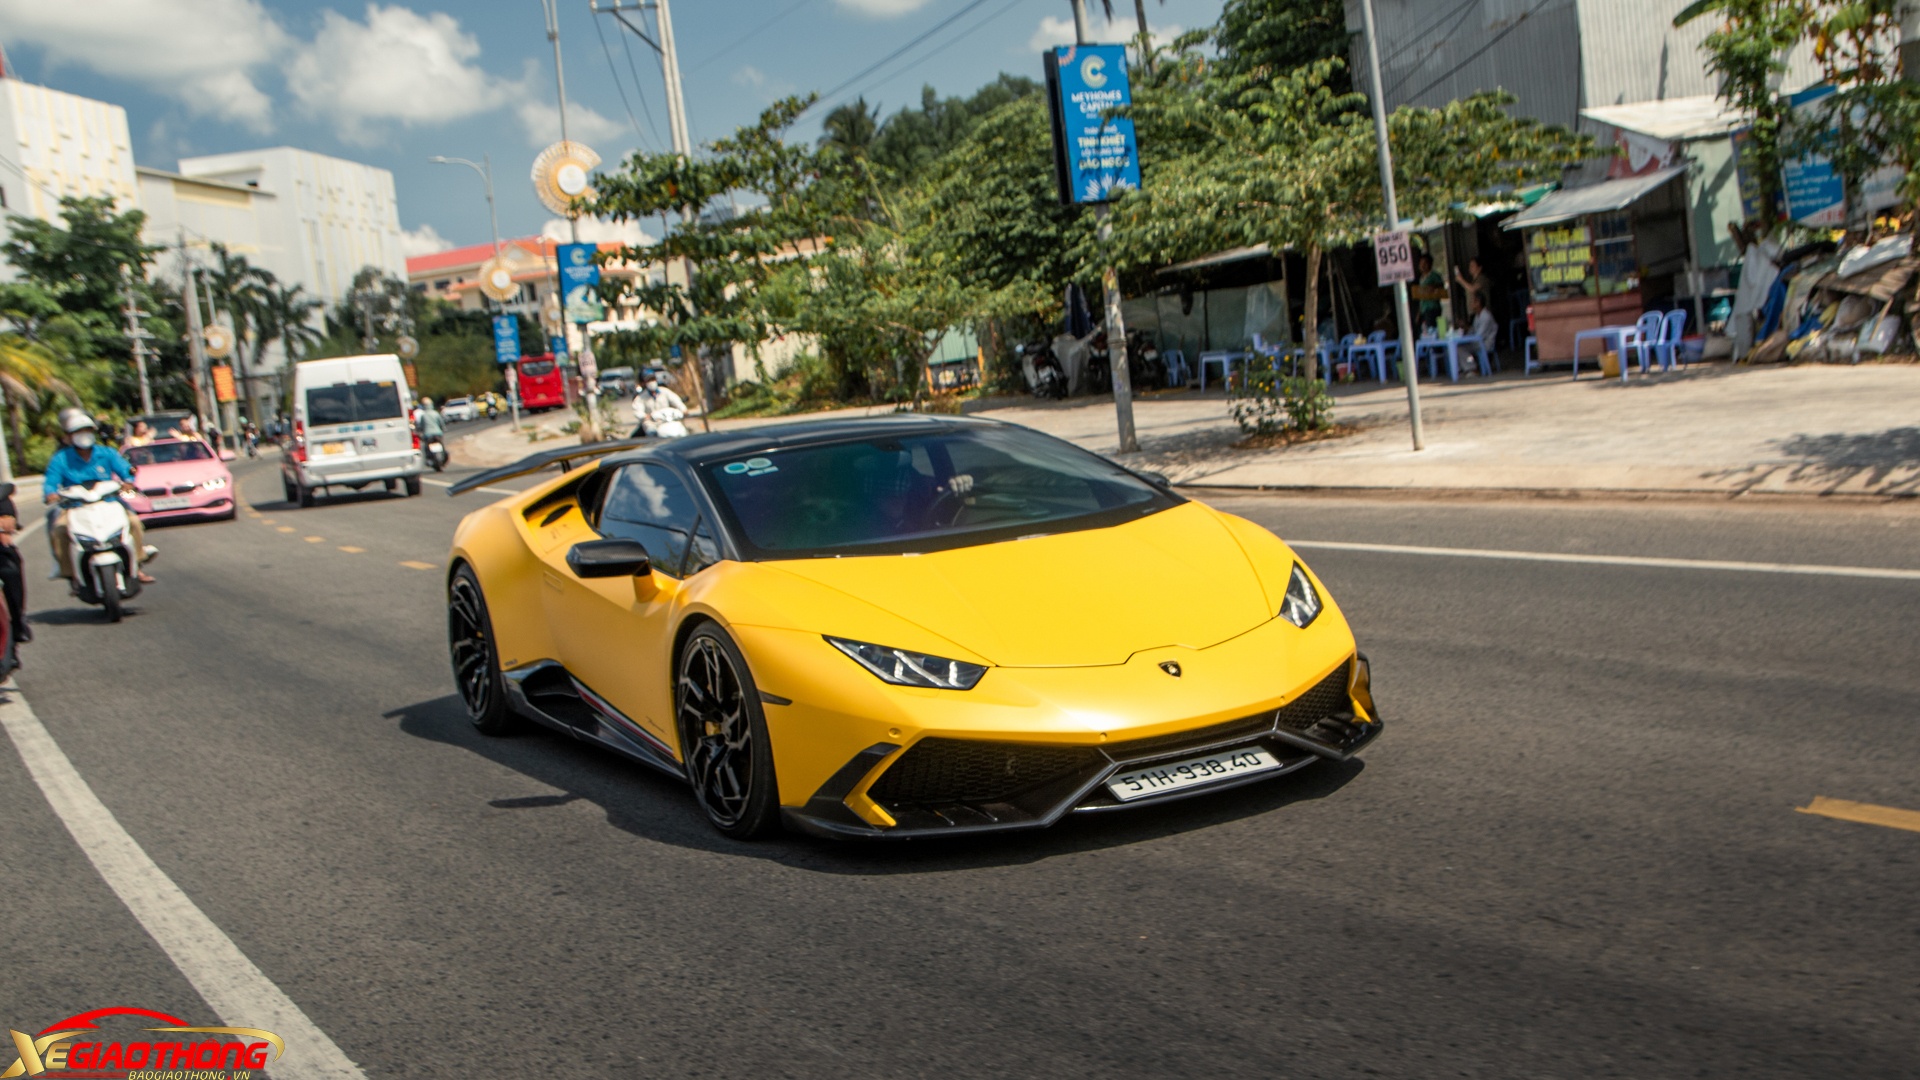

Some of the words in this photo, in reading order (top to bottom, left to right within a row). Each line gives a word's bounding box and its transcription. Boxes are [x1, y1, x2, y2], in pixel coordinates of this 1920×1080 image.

[1071, 90, 1122, 102] MEYHOMES
[1379, 243, 1408, 265] 950
[1121, 751, 1263, 792] 51H-938.40
